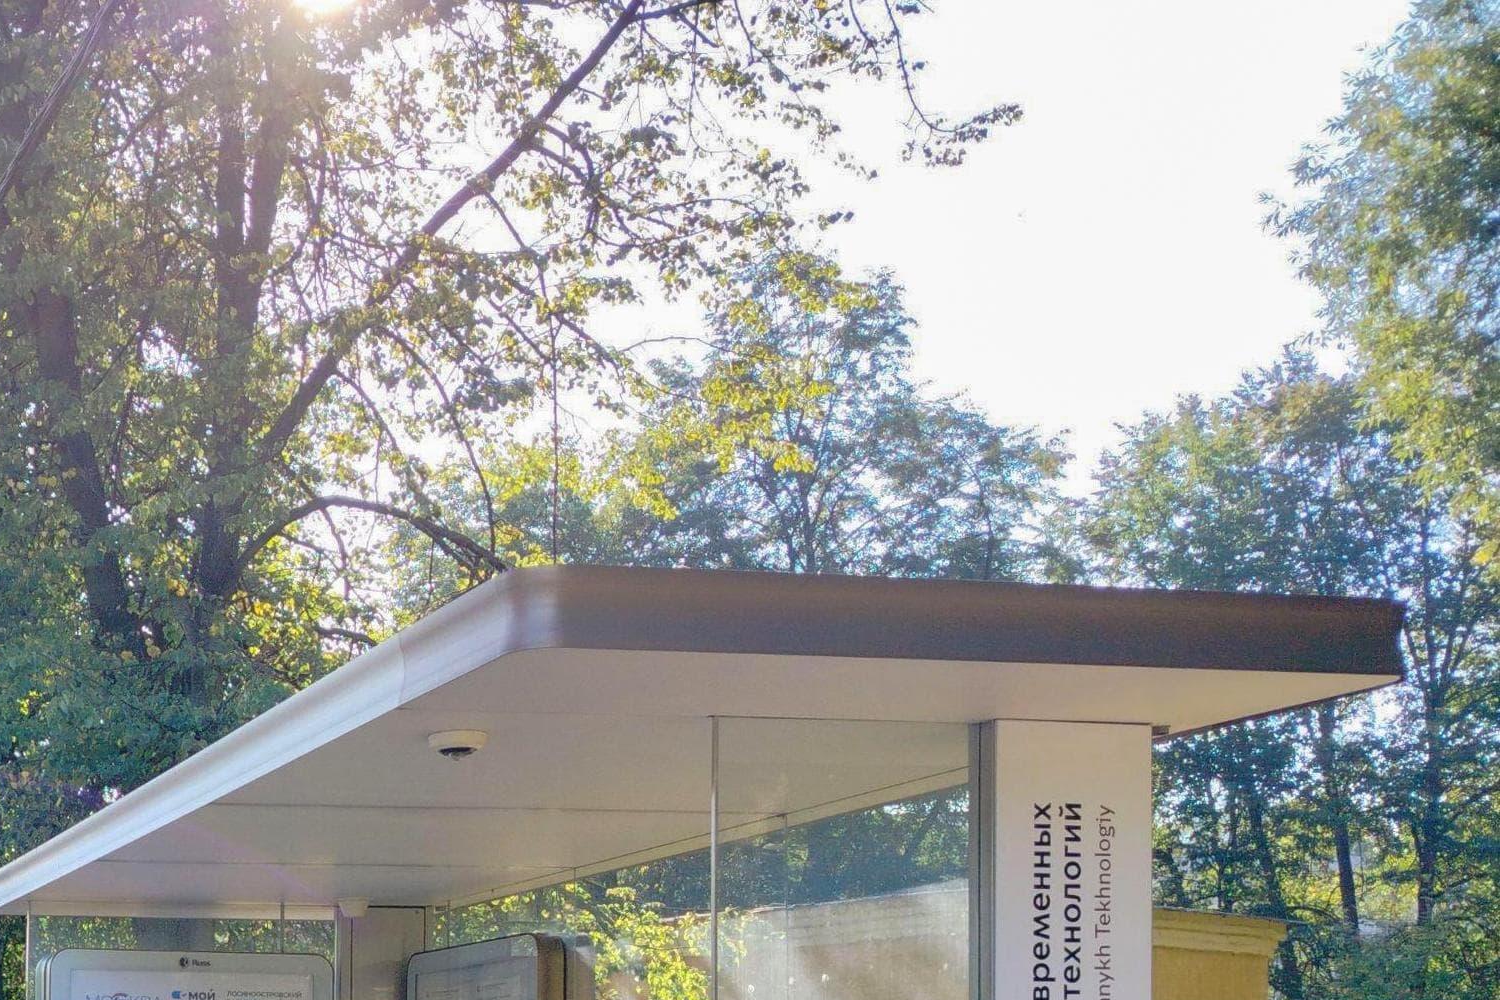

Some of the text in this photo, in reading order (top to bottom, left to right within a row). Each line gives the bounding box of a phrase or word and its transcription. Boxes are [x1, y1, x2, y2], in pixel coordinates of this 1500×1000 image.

[1058, 802, 1082, 1000] технологий
[1094, 804, 1116, 939] Tekhnologiy
[188, 988, 215, 1000] мой
